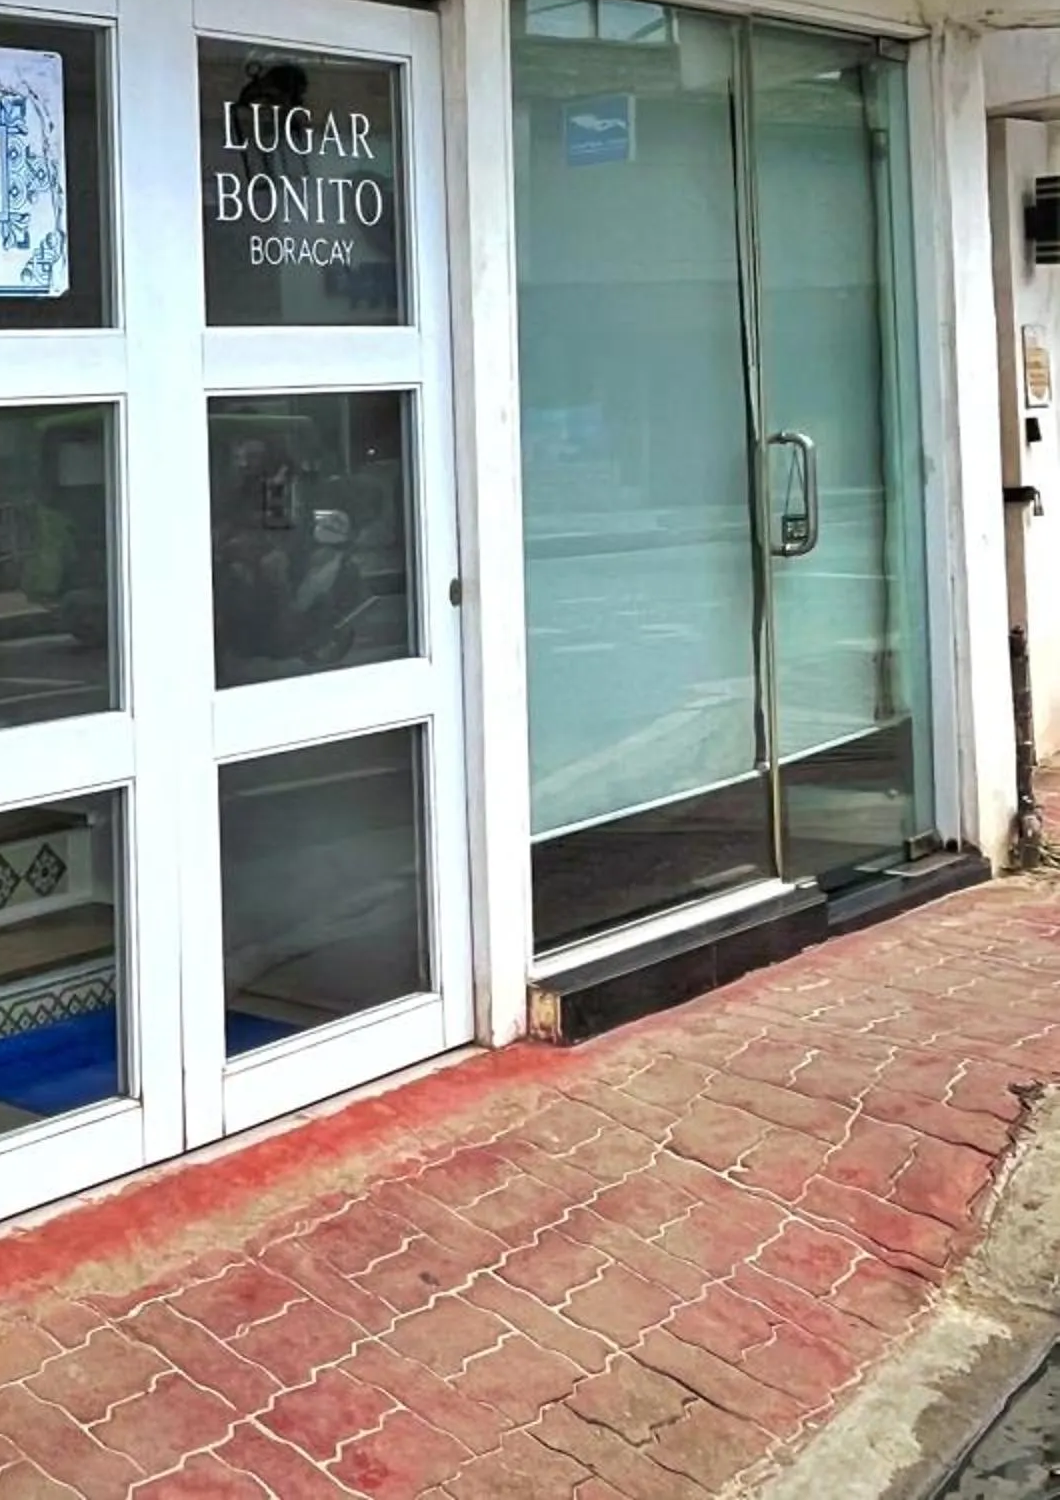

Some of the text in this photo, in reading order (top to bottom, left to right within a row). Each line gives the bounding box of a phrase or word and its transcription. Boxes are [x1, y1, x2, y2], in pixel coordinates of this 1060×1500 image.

[222, 101, 376, 159] LUGAR
[215, 172, 383, 227] BONITO
[249, 235, 355, 267] BORACAY
